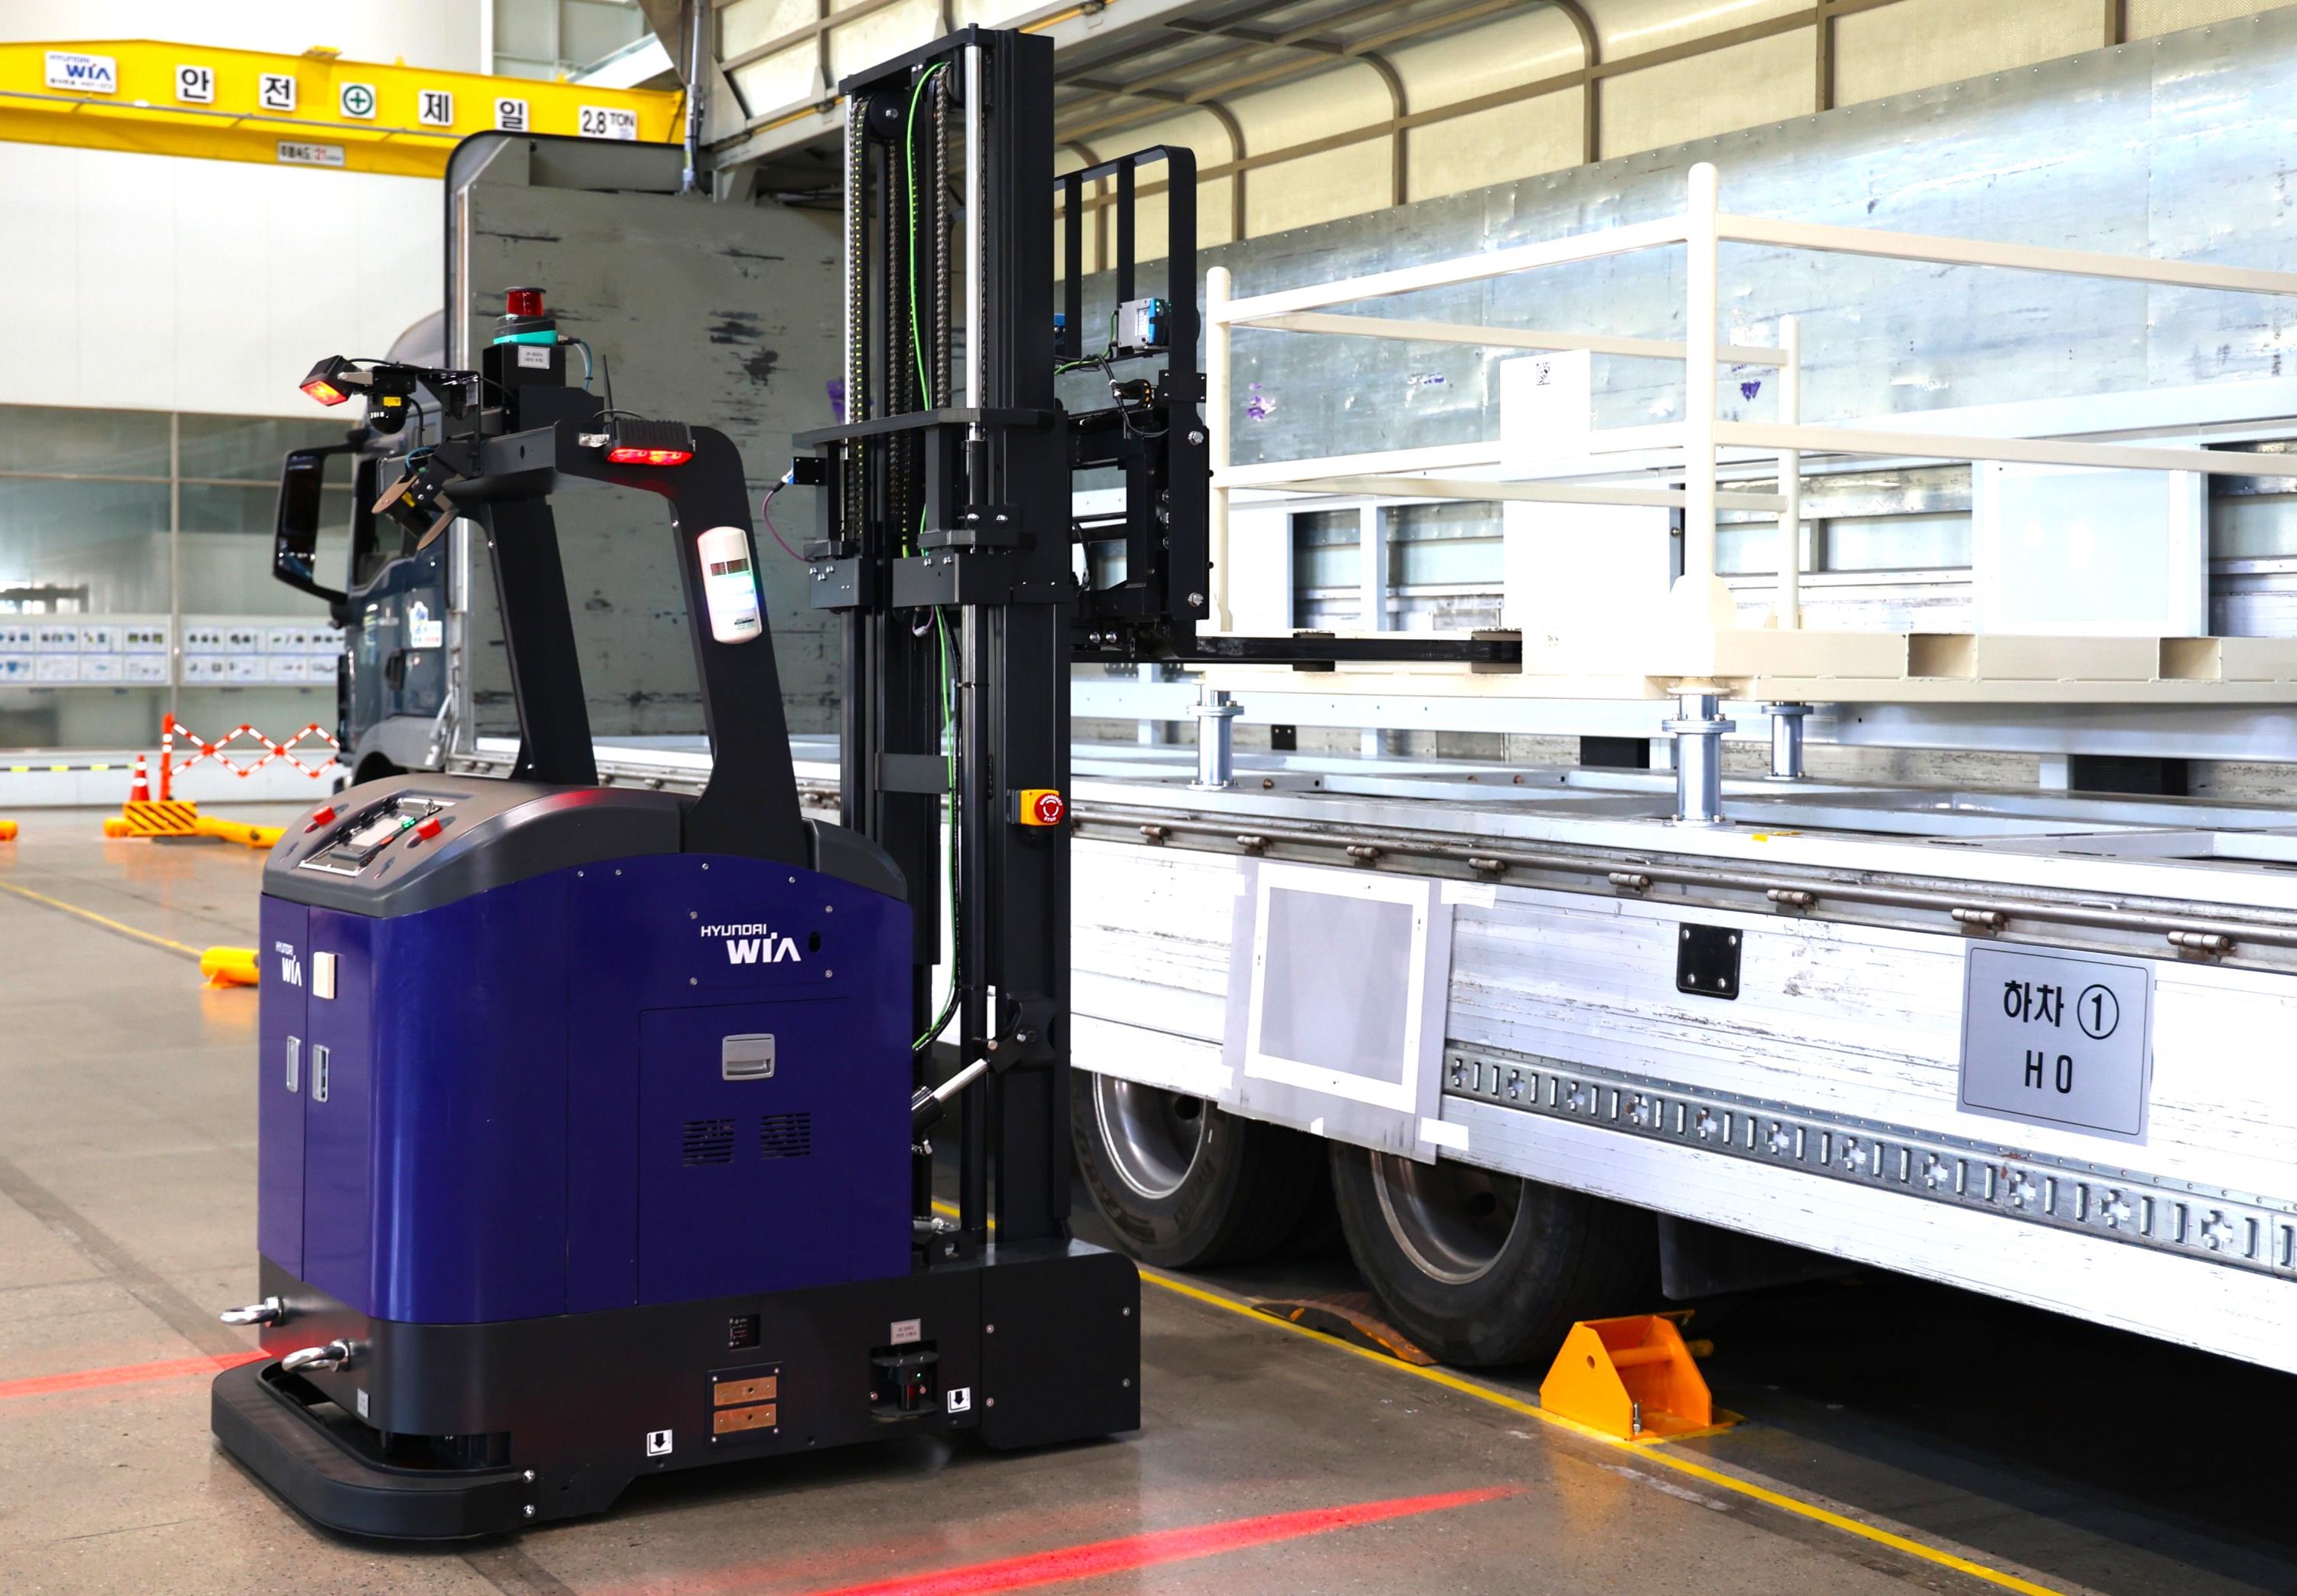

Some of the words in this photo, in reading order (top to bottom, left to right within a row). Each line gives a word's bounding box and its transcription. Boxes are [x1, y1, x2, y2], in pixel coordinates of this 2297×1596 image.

[66, 64, 111, 81] WIA
[609, 113, 635, 127] TON
[700, 923, 767, 938] HYUNDAI
[726, 932, 802, 964] WIA
[282, 955, 302, 987] WIA
[2003, 980, 2065, 1027] 하차
